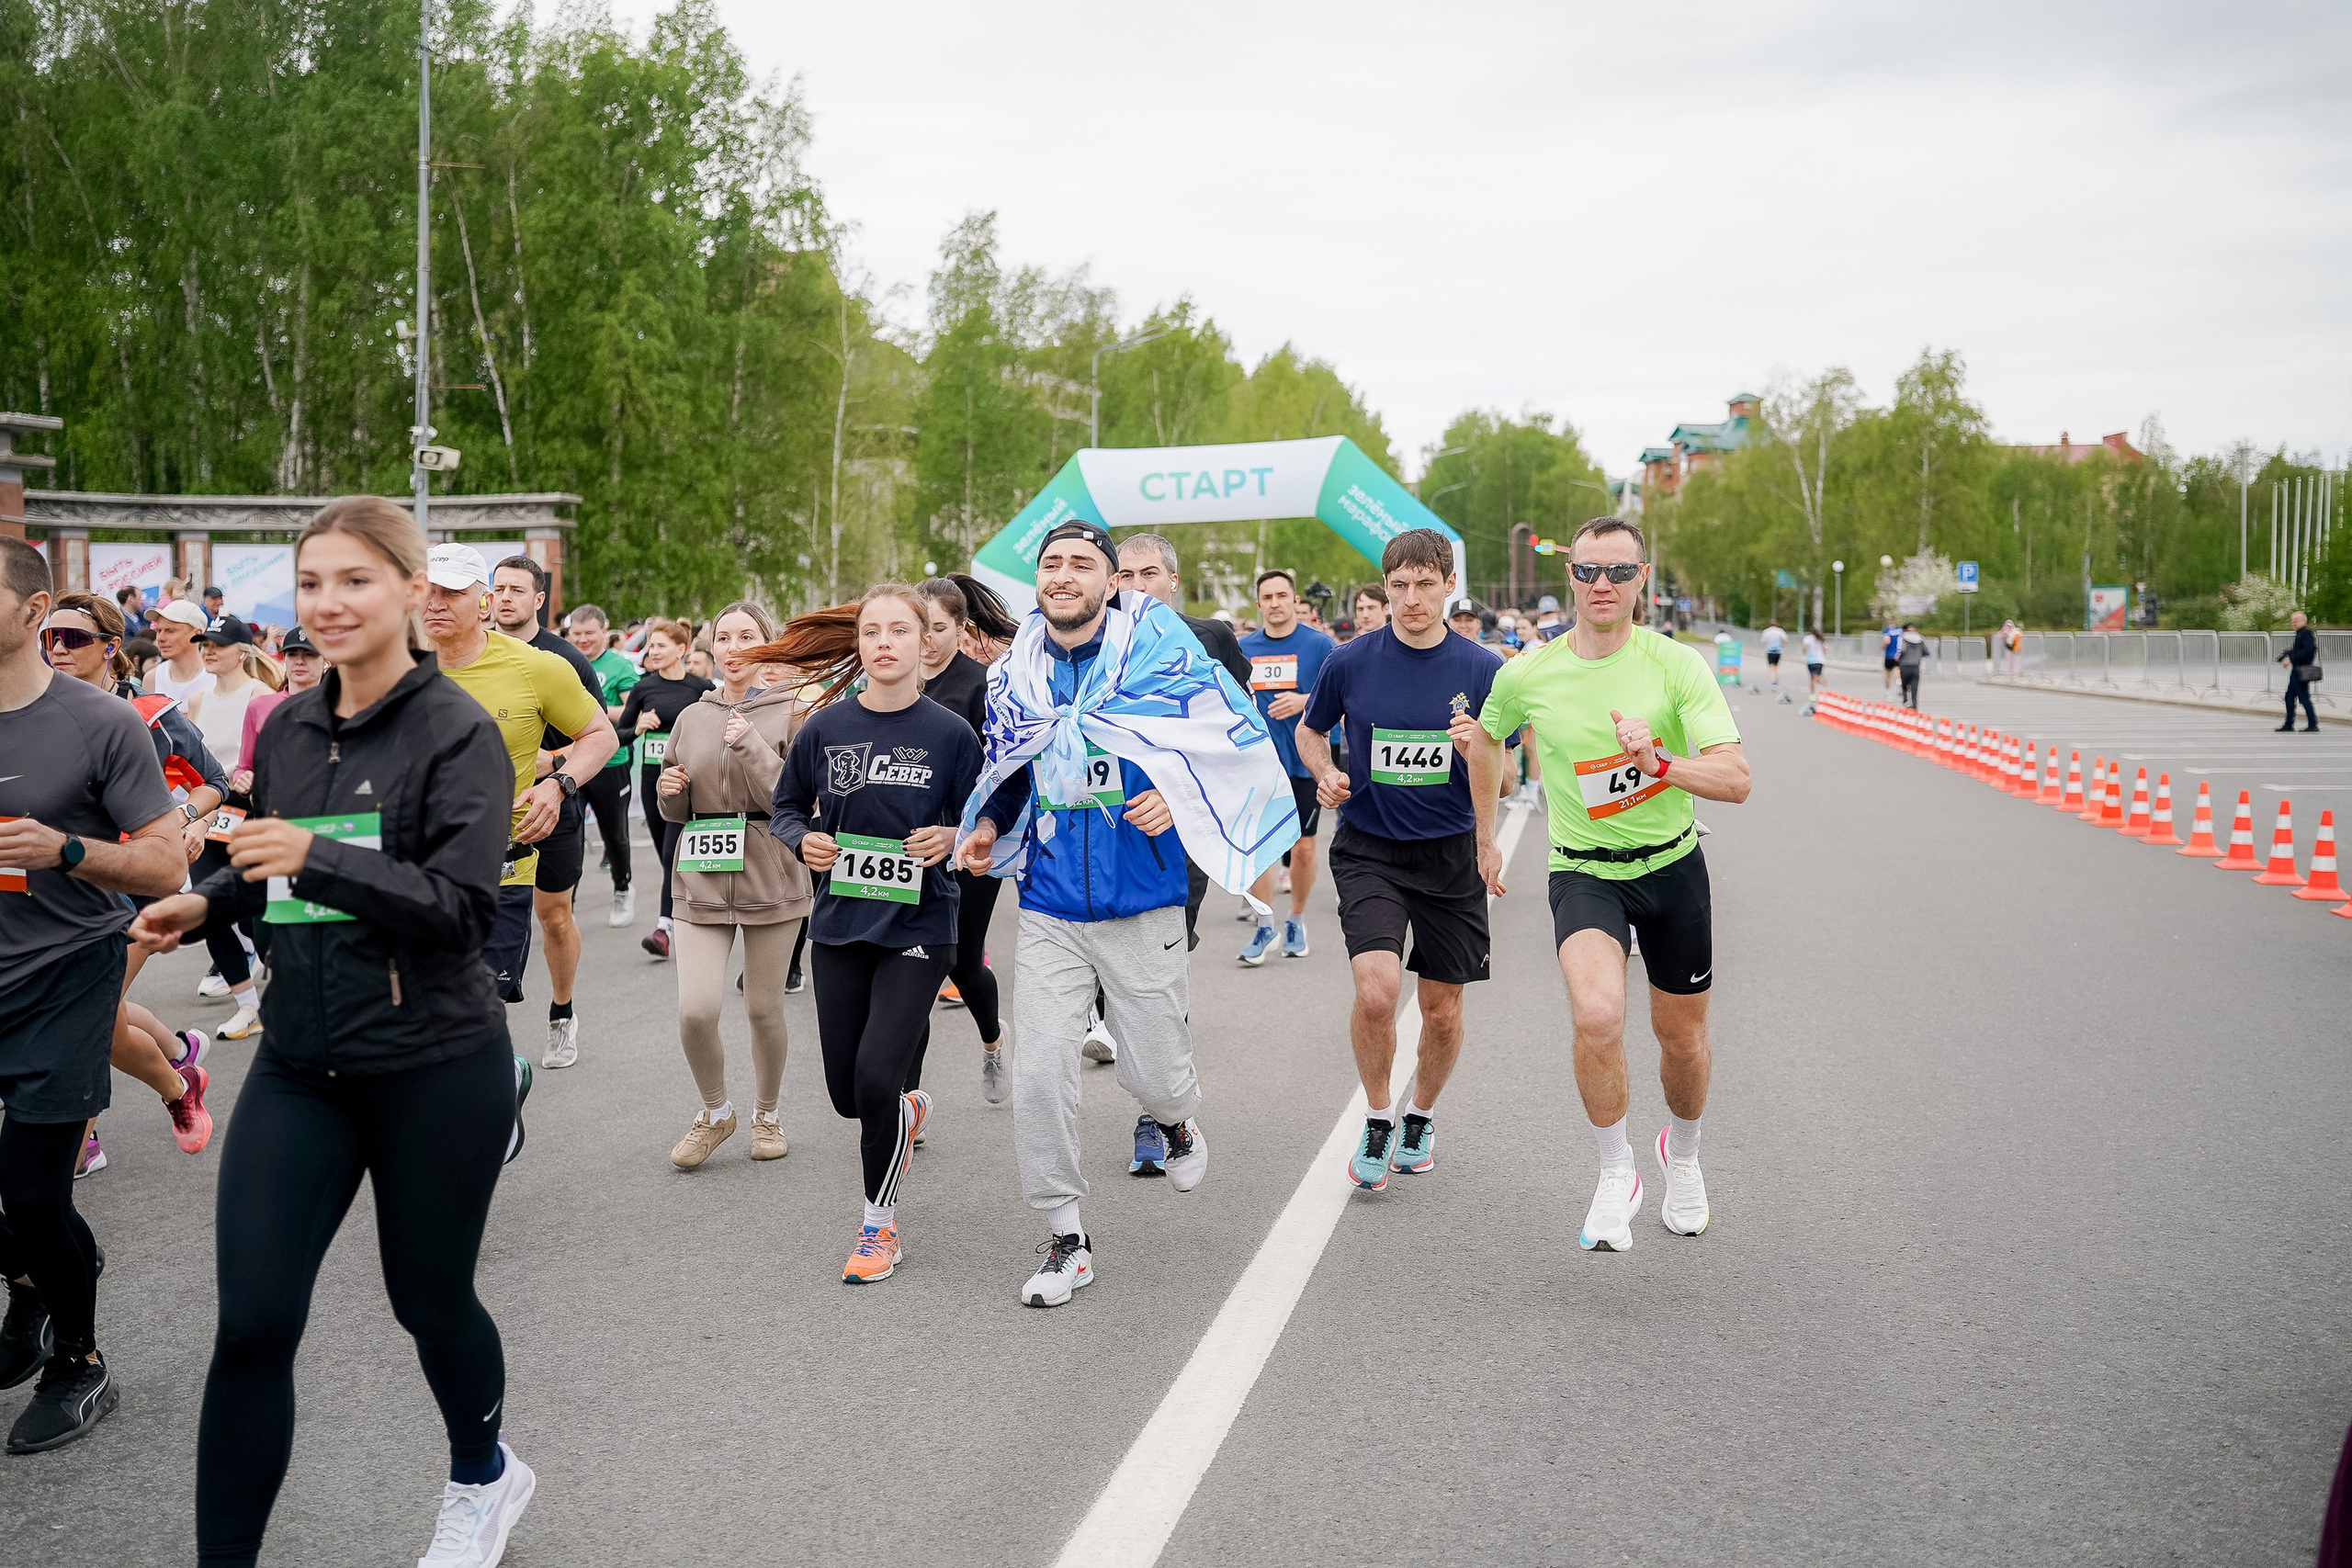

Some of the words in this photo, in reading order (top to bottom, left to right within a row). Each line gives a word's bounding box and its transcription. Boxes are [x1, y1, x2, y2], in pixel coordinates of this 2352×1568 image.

[1139, 467, 1274, 502] СТАРТ
[98, 556, 133, 581] БЫТЬ
[107, 553, 164, 591] РОССИЕЙ
[1264, 666, 1282, 678] 30
[1381, 746, 1443, 768] 1446
[1087, 761, 1110, 787] 9
[1609, 766, 1642, 794] 49
[687, 834, 738, 855] 1555
[843, 853, 914, 884] 1685
[901, 952, 930, 960] adidas
